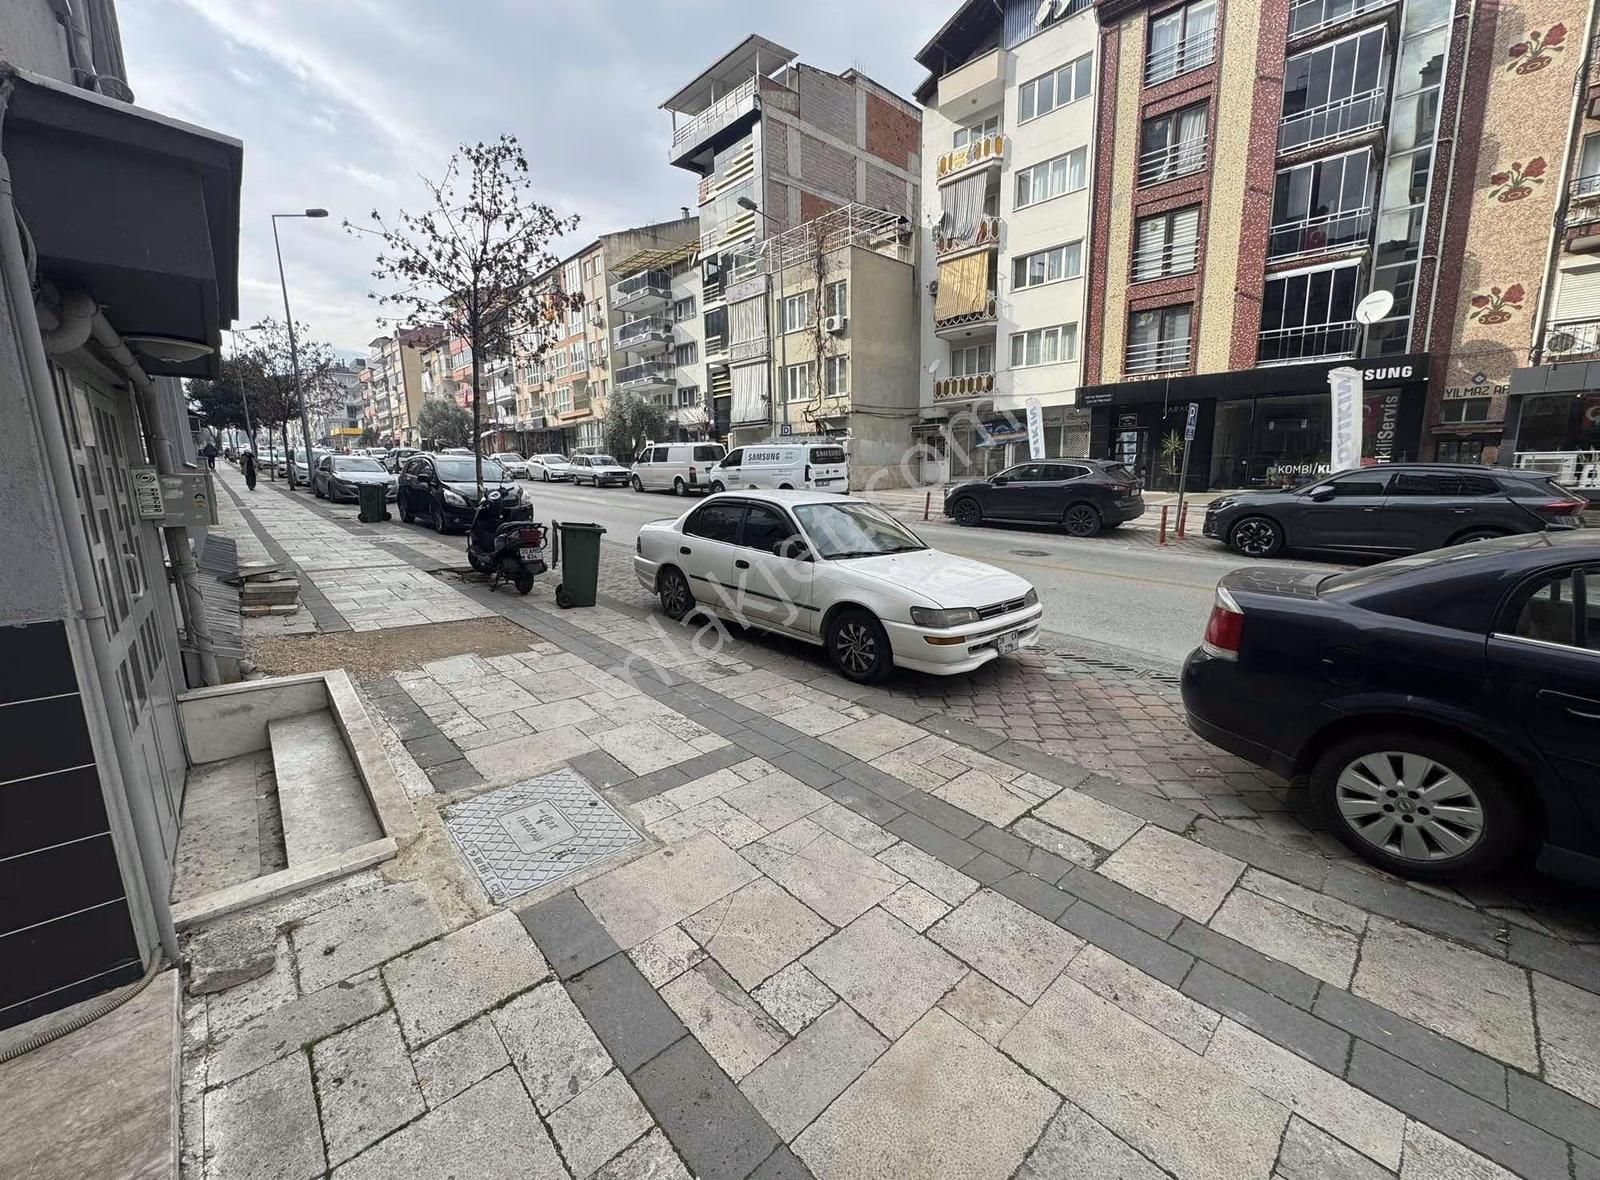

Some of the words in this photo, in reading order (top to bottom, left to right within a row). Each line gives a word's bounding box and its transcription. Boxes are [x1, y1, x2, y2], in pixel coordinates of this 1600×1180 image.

[1326, 366, 1413, 384] SUNG
[1445, 386, 1490, 398] YILMAZ
[783, 426, 790, 434] D
[1374, 394, 1399, 464] tkiliServis
[748, 452, 780, 461] SAMSUNG
